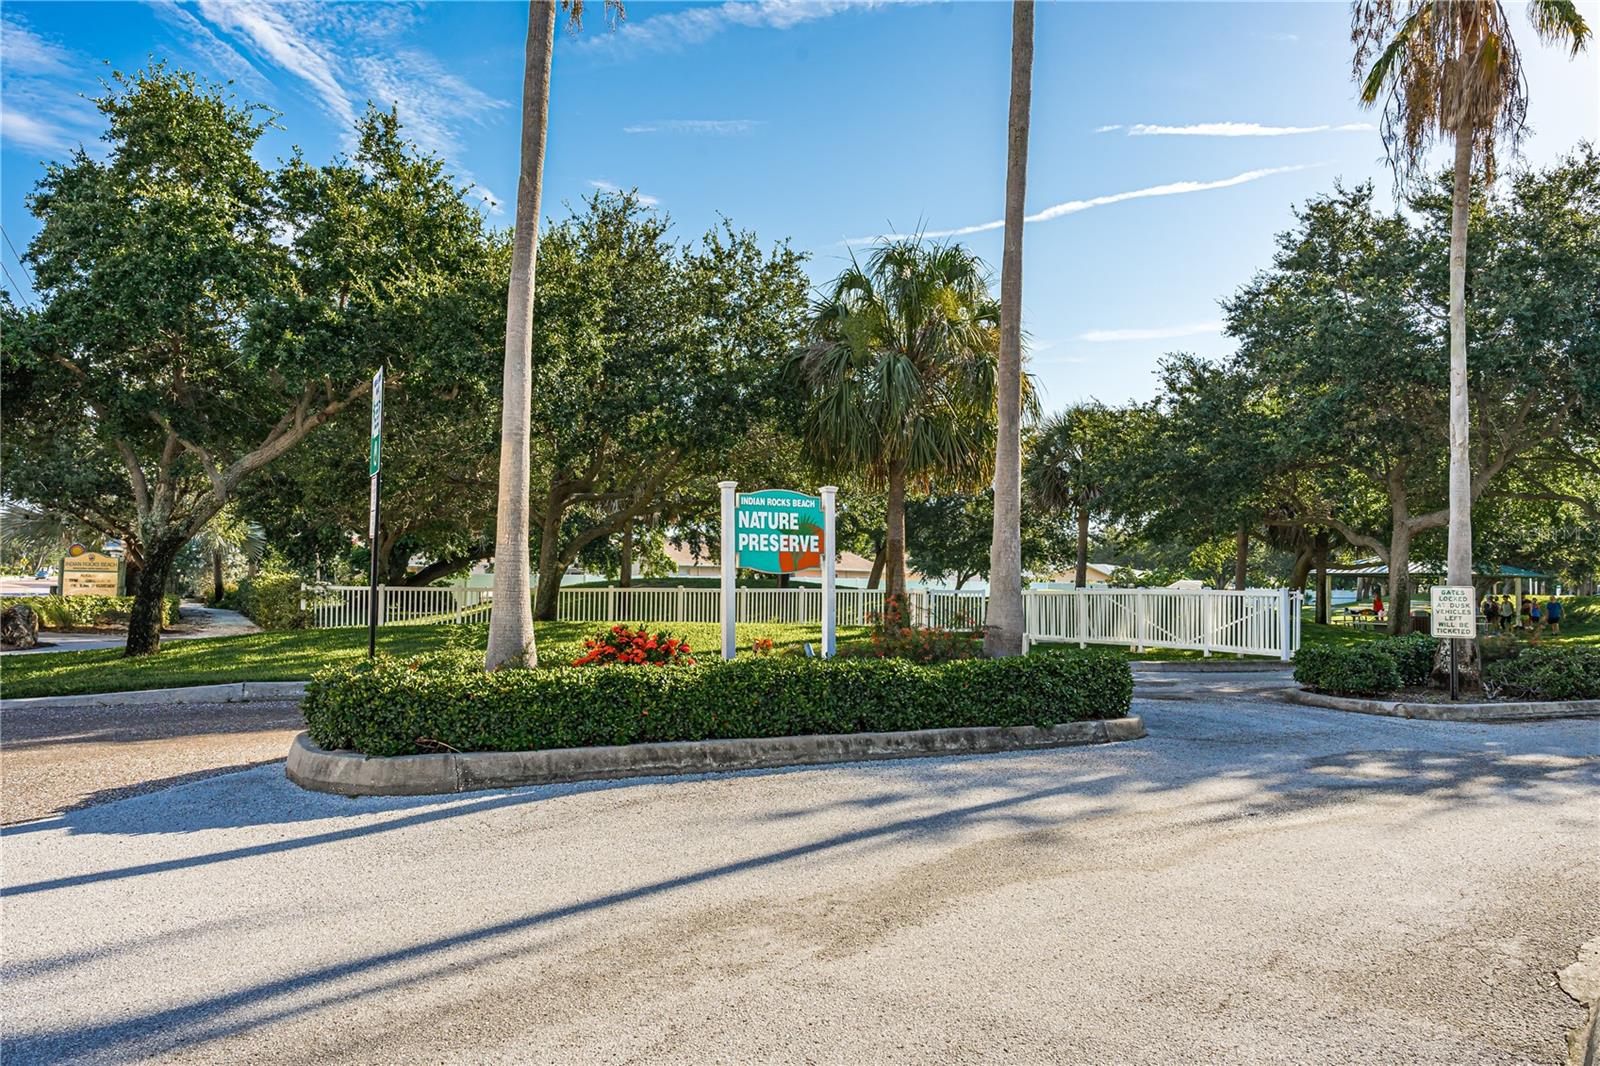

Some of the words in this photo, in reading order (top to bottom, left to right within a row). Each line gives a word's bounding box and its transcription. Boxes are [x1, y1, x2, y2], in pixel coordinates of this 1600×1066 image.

[740, 497, 766, 506] INDIAN
[767, 497, 791, 507] ROCKS
[792, 499, 816, 508] BEACH
[738, 511, 799, 530] NATURE
[738, 533, 820, 552] PRESERVE
